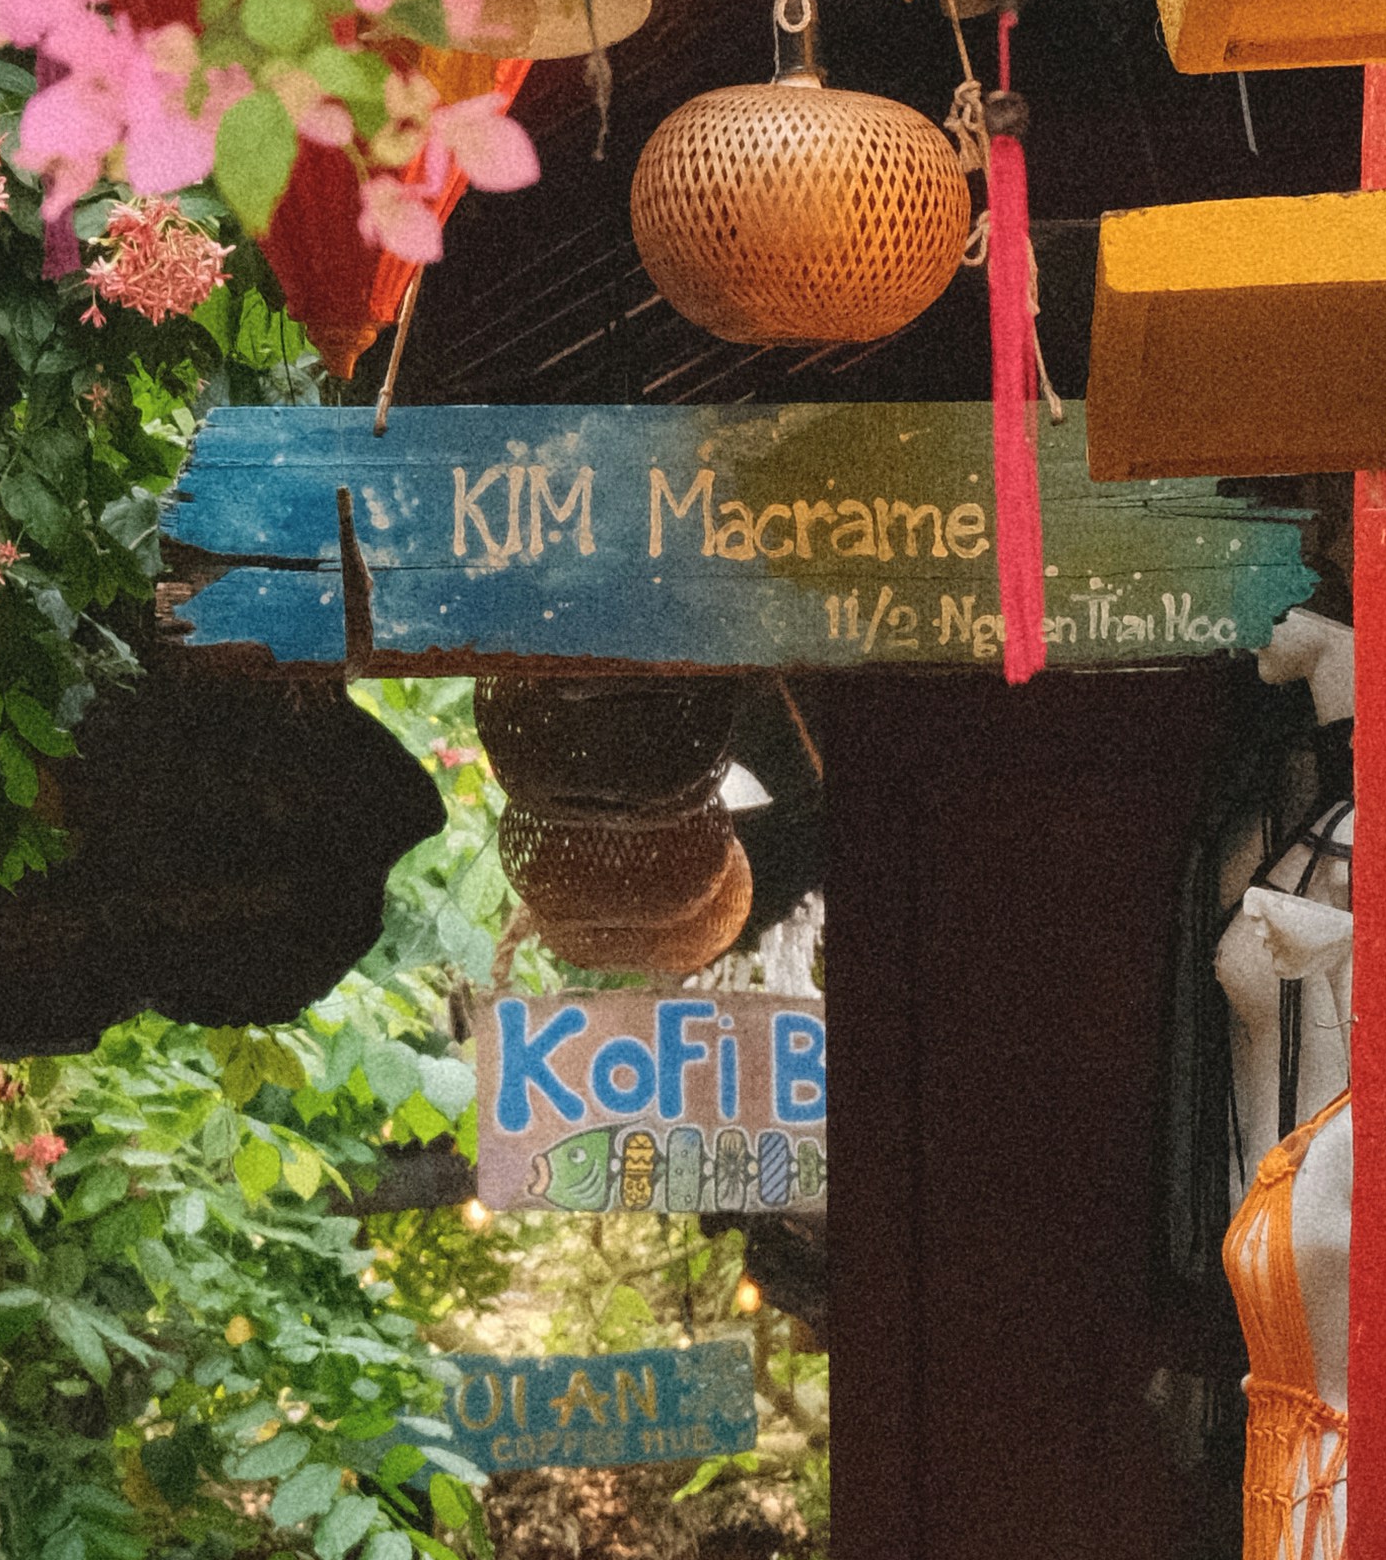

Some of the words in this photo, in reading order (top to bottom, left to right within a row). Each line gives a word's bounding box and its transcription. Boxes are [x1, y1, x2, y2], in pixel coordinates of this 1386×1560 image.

[453, 465, 596, 559] KIM
[648, 467, 990, 561] Macrame
[824, 586, 919, 653] 11/2
[938, 594, 1077, 658] Ngen
[495, 997, 740, 1133] KoFi
[548, 1364, 657, 1428] AN
